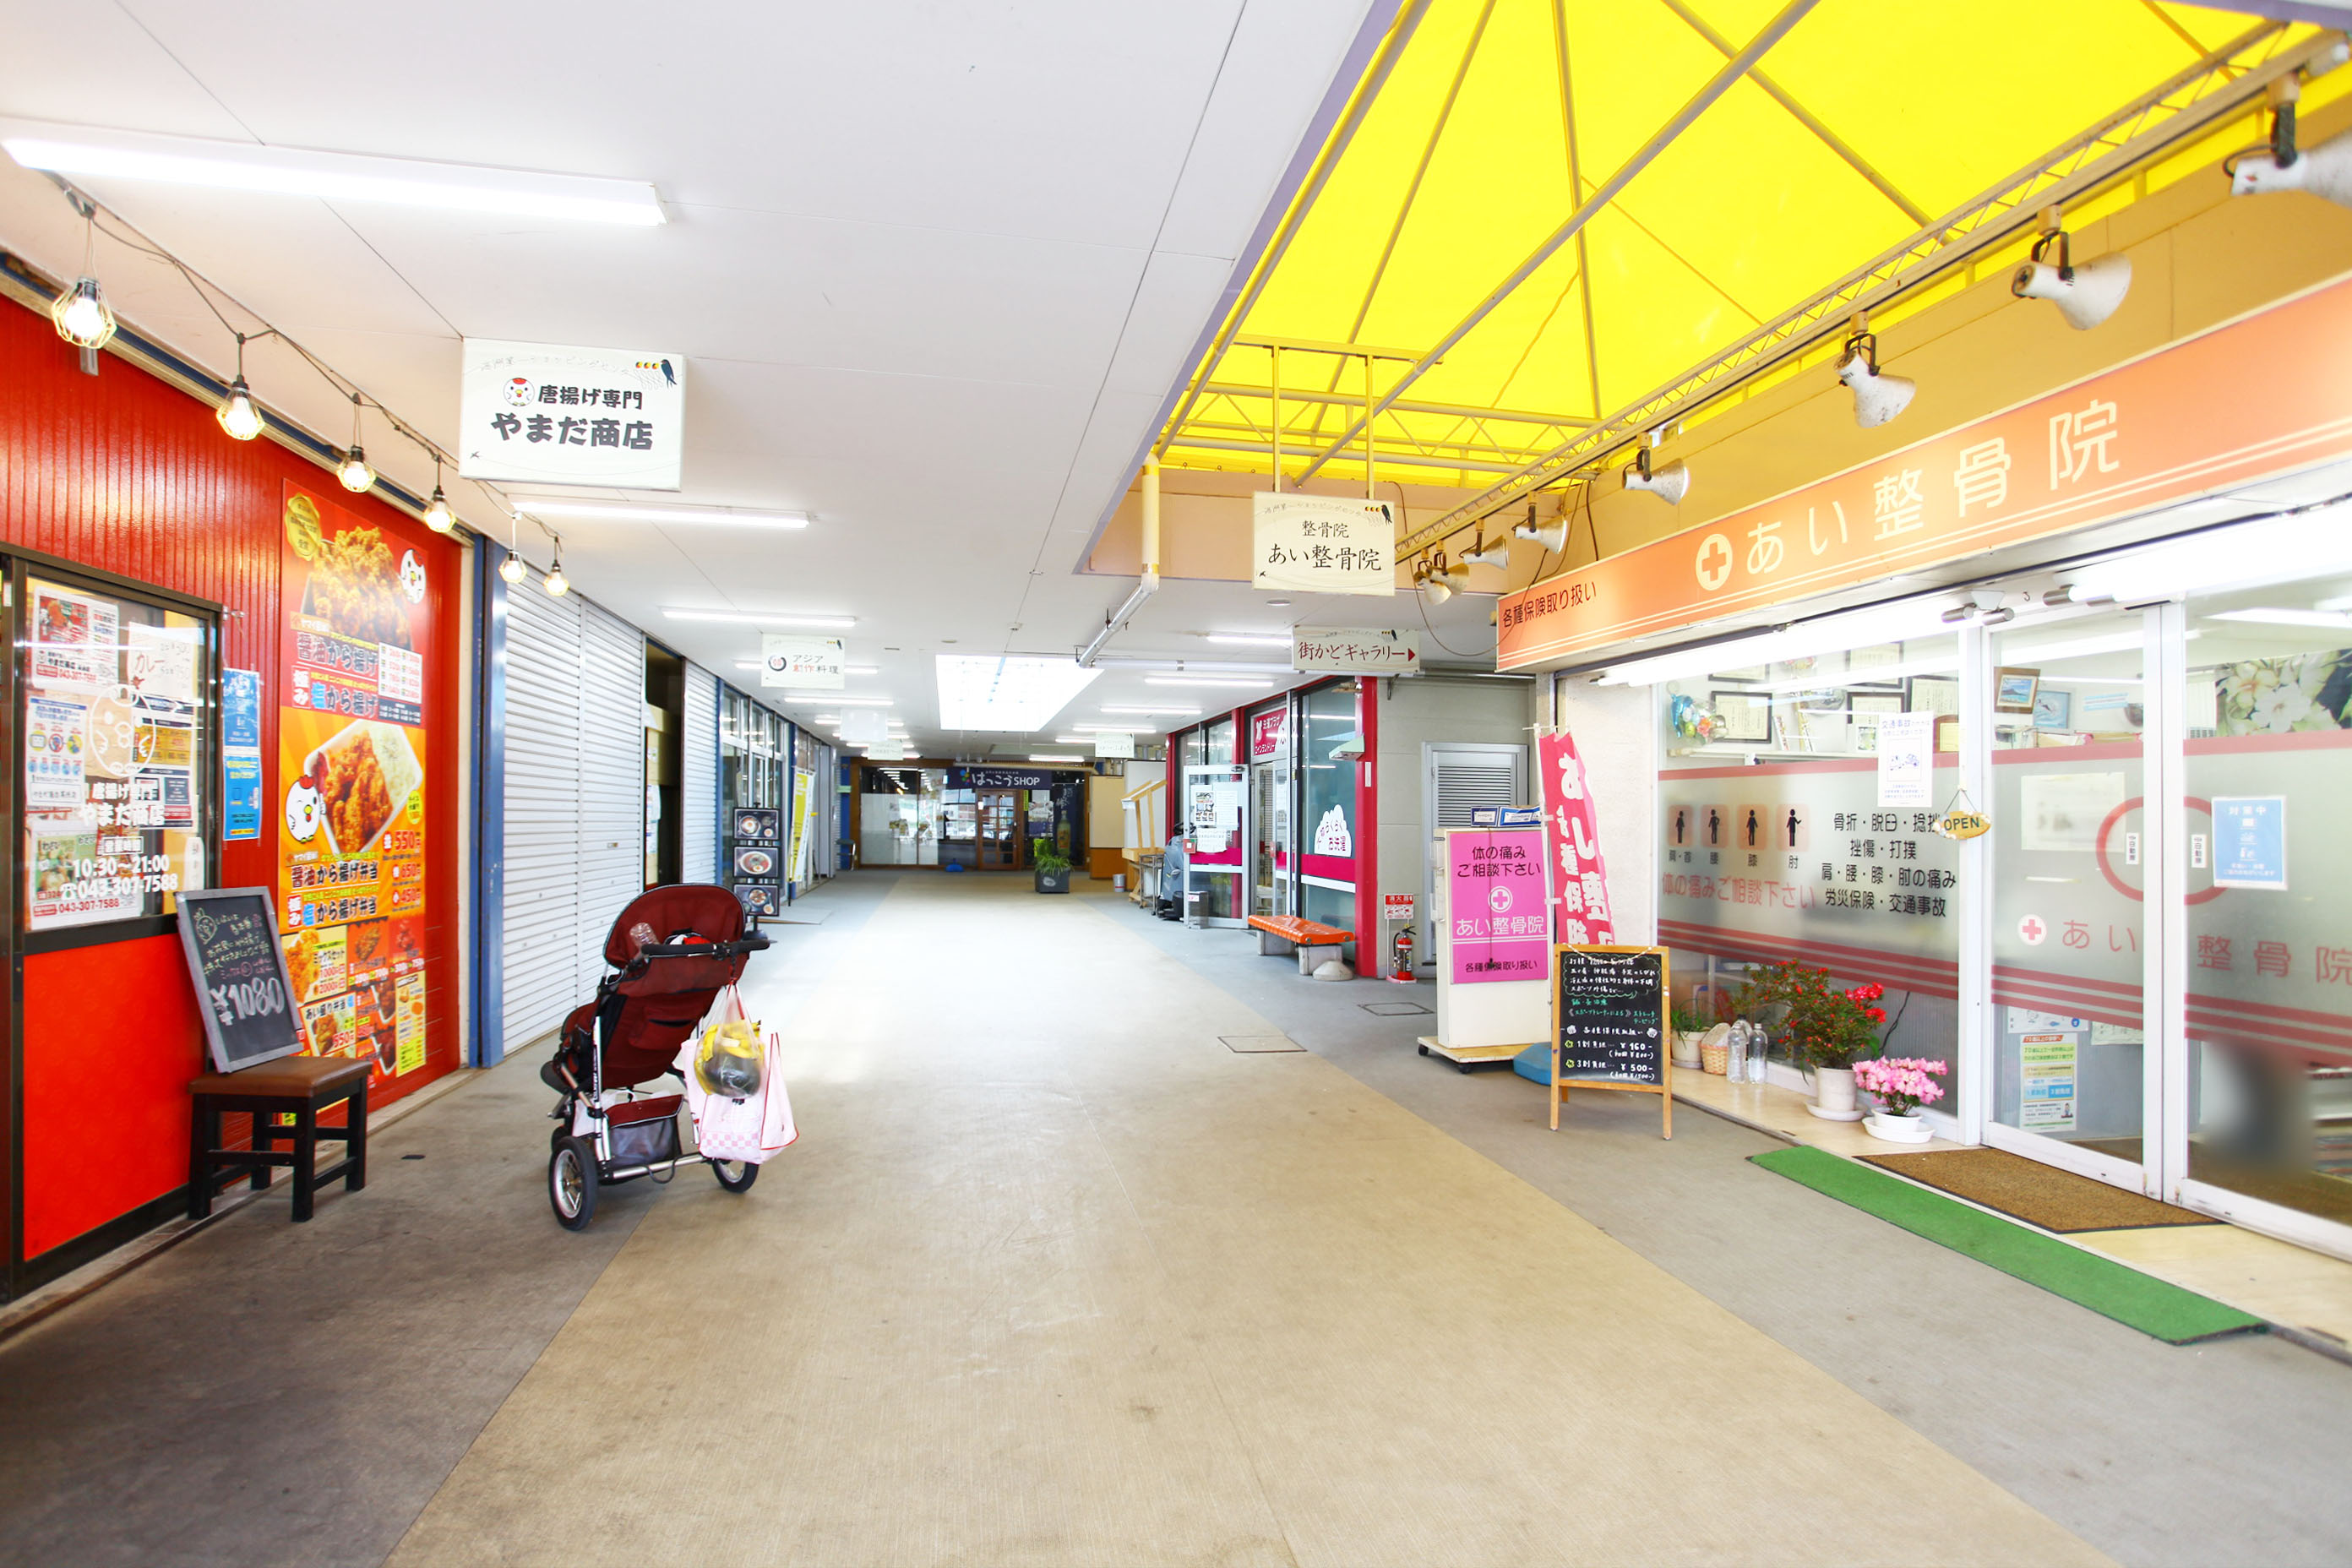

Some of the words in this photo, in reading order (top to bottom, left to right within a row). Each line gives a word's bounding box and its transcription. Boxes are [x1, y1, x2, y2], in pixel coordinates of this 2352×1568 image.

[538, 384, 643, 410] 唐揚げ専門
[491, 412, 653, 450] やまだ商店
[1746, 399, 2119, 575] あい整骨院
[1302, 520, 1349, 538] 整骨院
[1268, 543, 1381, 571] あい整骨院
[1503, 581, 1597, 628] 各種保険取り扱い
[792, 654, 824, 663] アジア
[1298, 640, 1406, 662] 街かどギャラリー
[972, 771, 1040, 787] はっこうSHOP
[80, 803, 165, 826] やまだ商店
[1944, 817, 1980, 831] OPEN
[1472, 846, 1526, 860] 体の痛み
[1850, 839, 1917, 859] 挫傷・打撲
[1457, 863, 1540, 877] ご相談下さい
[1788, 855, 1798, 869] 肘
[1821, 863, 1956, 888] 肩・腰・膝・肘の痛み
[1663, 872, 1816, 909] 体の痛みご相談下さい
[58, 898, 120, 913] 043-307-7588
[1826, 889, 1946, 917] 労災保険・交通事故
[1456, 916, 1544, 937] あい整骨院
